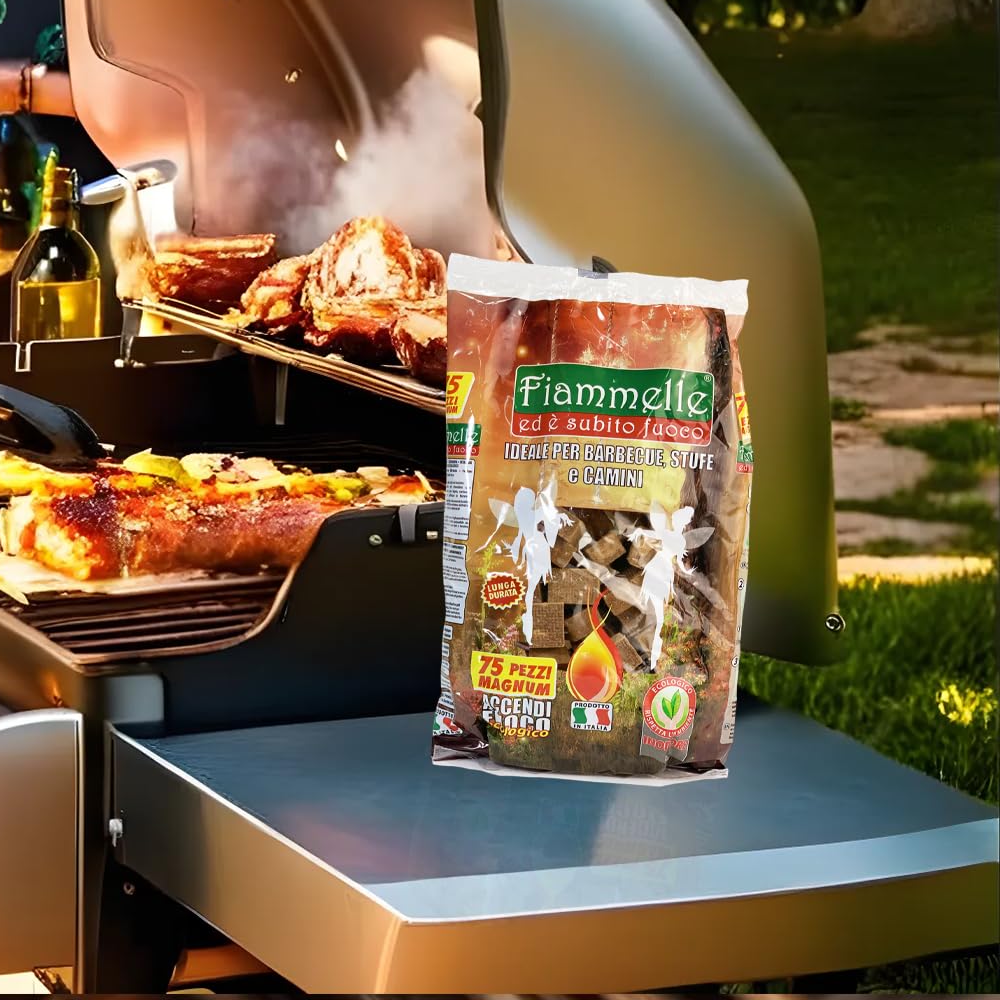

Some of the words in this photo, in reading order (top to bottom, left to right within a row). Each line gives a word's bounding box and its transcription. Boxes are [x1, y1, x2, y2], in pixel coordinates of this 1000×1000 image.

[520, 373, 709, 417] Fiammelle
[519, 414, 541, 433] ed
[548, 413, 559, 433] è
[566, 414, 635, 434] subito
[642, 417, 704, 441] fuoco
[504, 442, 550, 461] IDEALE
[551, 442, 581, 461] PER
[584, 444, 667, 469] BARBECUE,
[670, 450, 715, 471] STUFE
[568, 468, 579, 484] e
[583, 466, 644, 488] CAMINI
[487, 580, 516, 593] LUNGA
[488, 588, 518, 600] DURATA
[478, 655, 505, 677] 75
[508, 663, 553, 680] PEZZI
[478, 675, 551, 696] MAGNUM
[651, 678, 693, 694] ECOLOGICO
[482, 693, 552, 718] ACCENDI
[574, 702, 610, 710] PRODOTTO
[644, 709, 667, 737] RISPETTA
